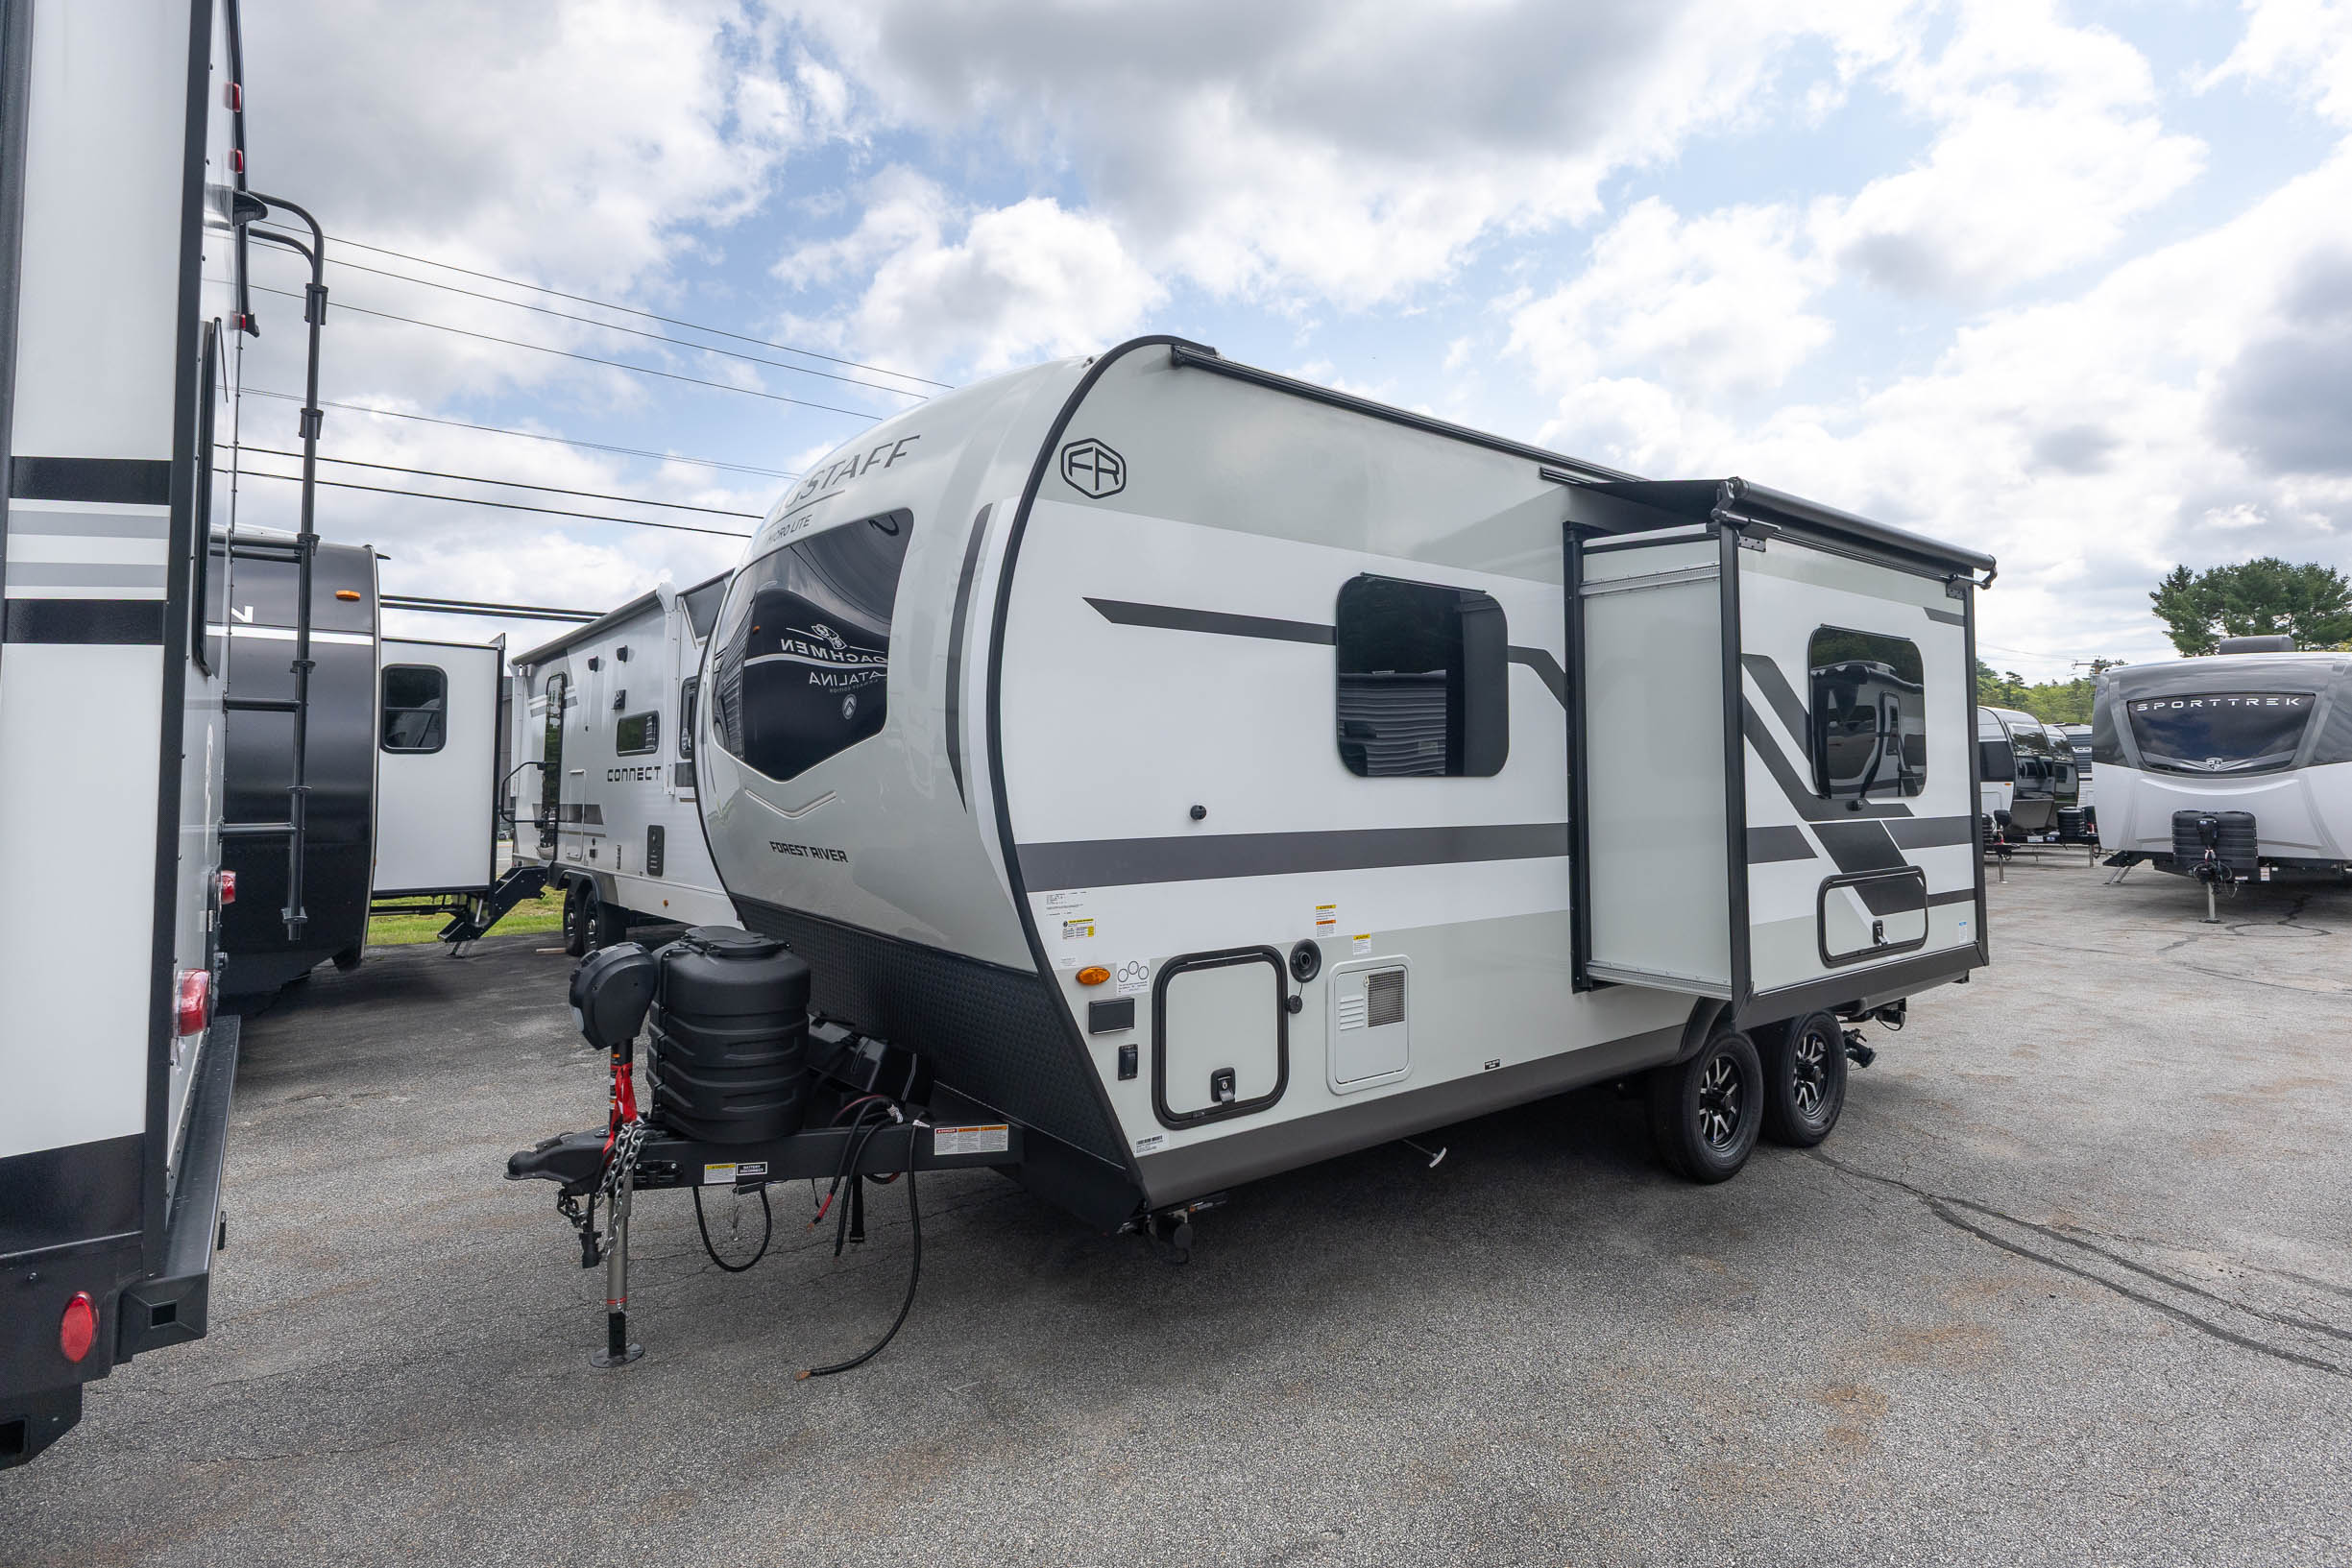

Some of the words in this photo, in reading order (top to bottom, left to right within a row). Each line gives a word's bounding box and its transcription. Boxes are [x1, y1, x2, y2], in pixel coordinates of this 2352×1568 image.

[789, 514, 812, 534] LITE
[2137, 698, 2301, 712] SPORTTREK
[607, 765, 662, 782] CONNECT
[768, 841, 809, 856] FOREST
[809, 846, 849, 863] RIVER
